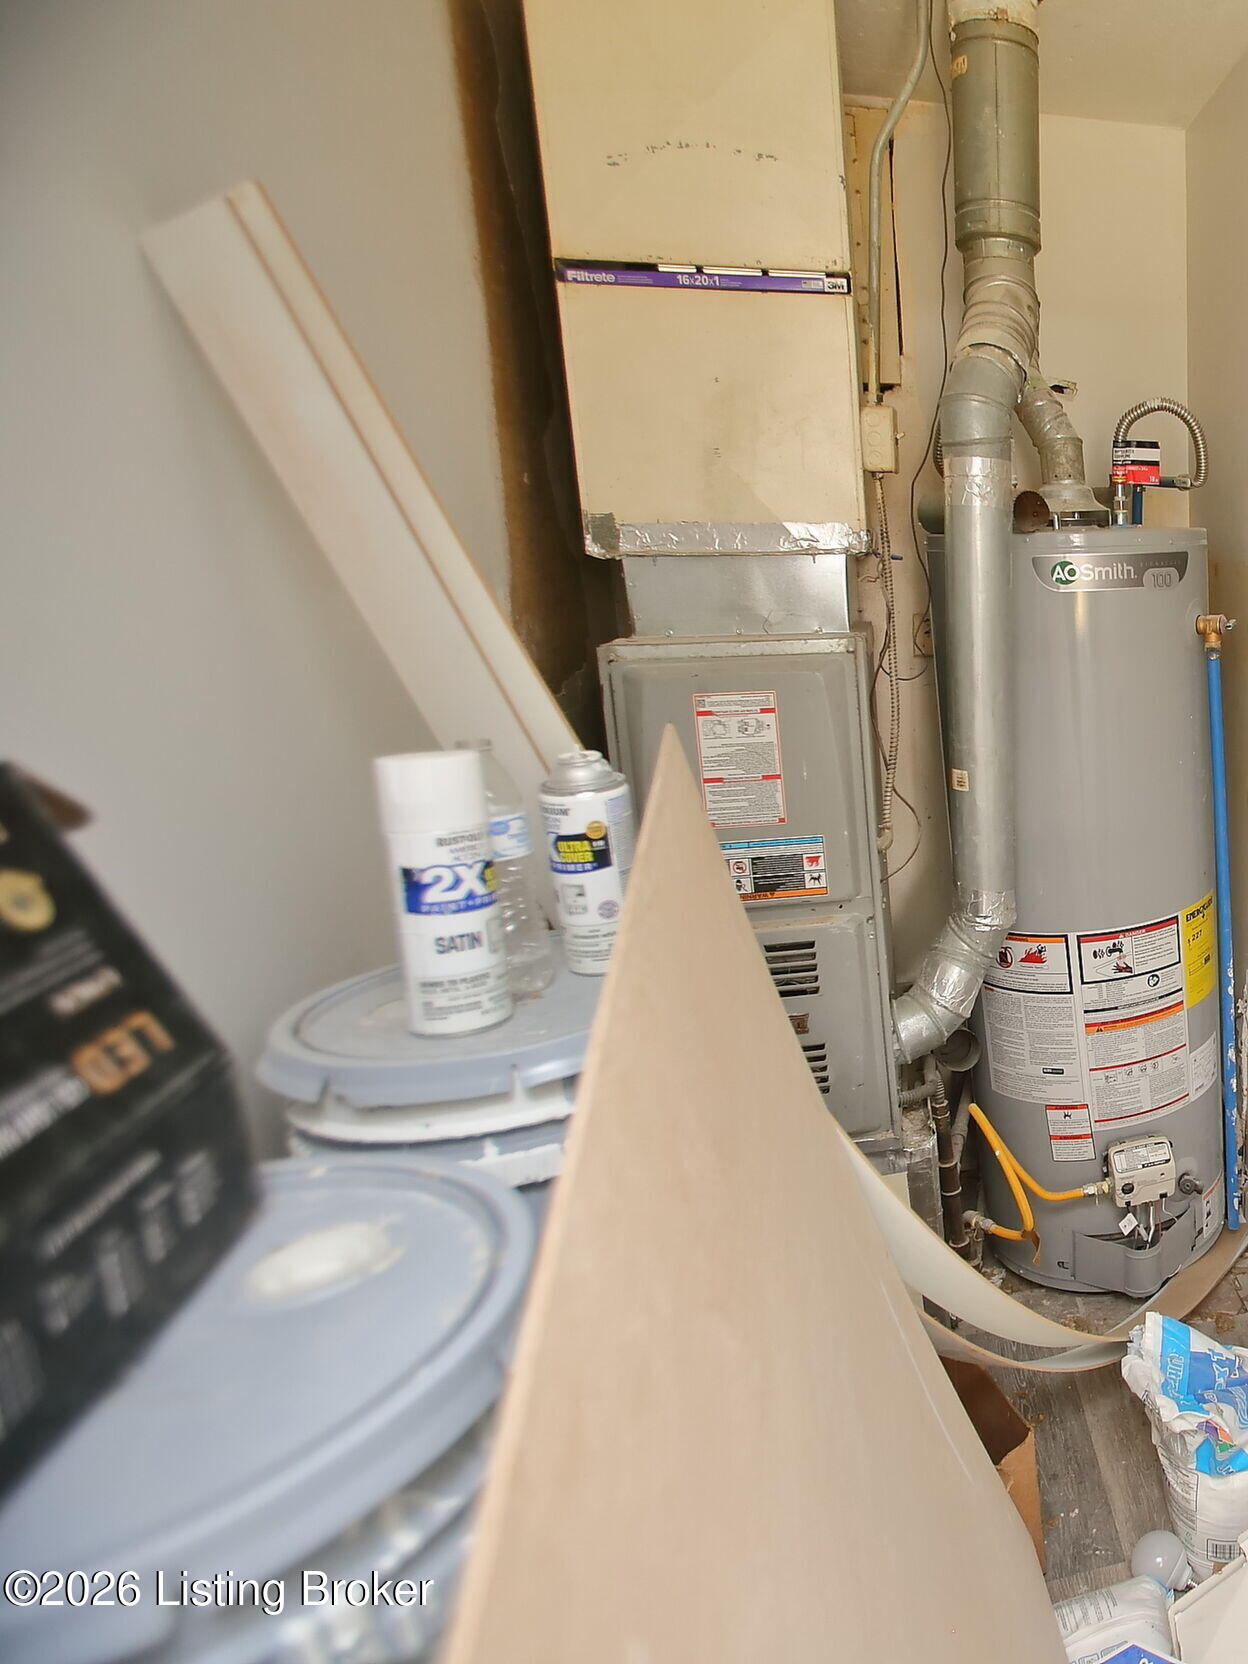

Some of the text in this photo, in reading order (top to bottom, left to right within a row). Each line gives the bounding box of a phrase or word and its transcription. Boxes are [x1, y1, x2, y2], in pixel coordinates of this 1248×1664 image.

[566, 270, 616, 284] Filtrete
[676, 274, 721, 287] 16x20x1
[828, 279, 846, 292] 3M
[556, 840, 592, 854] ULTRA
[559, 851, 594, 863] COVER
[420, 860, 487, 905] 2X
[433, 930, 483, 955] SATIN
[70, 1008, 176, 1096] LED
